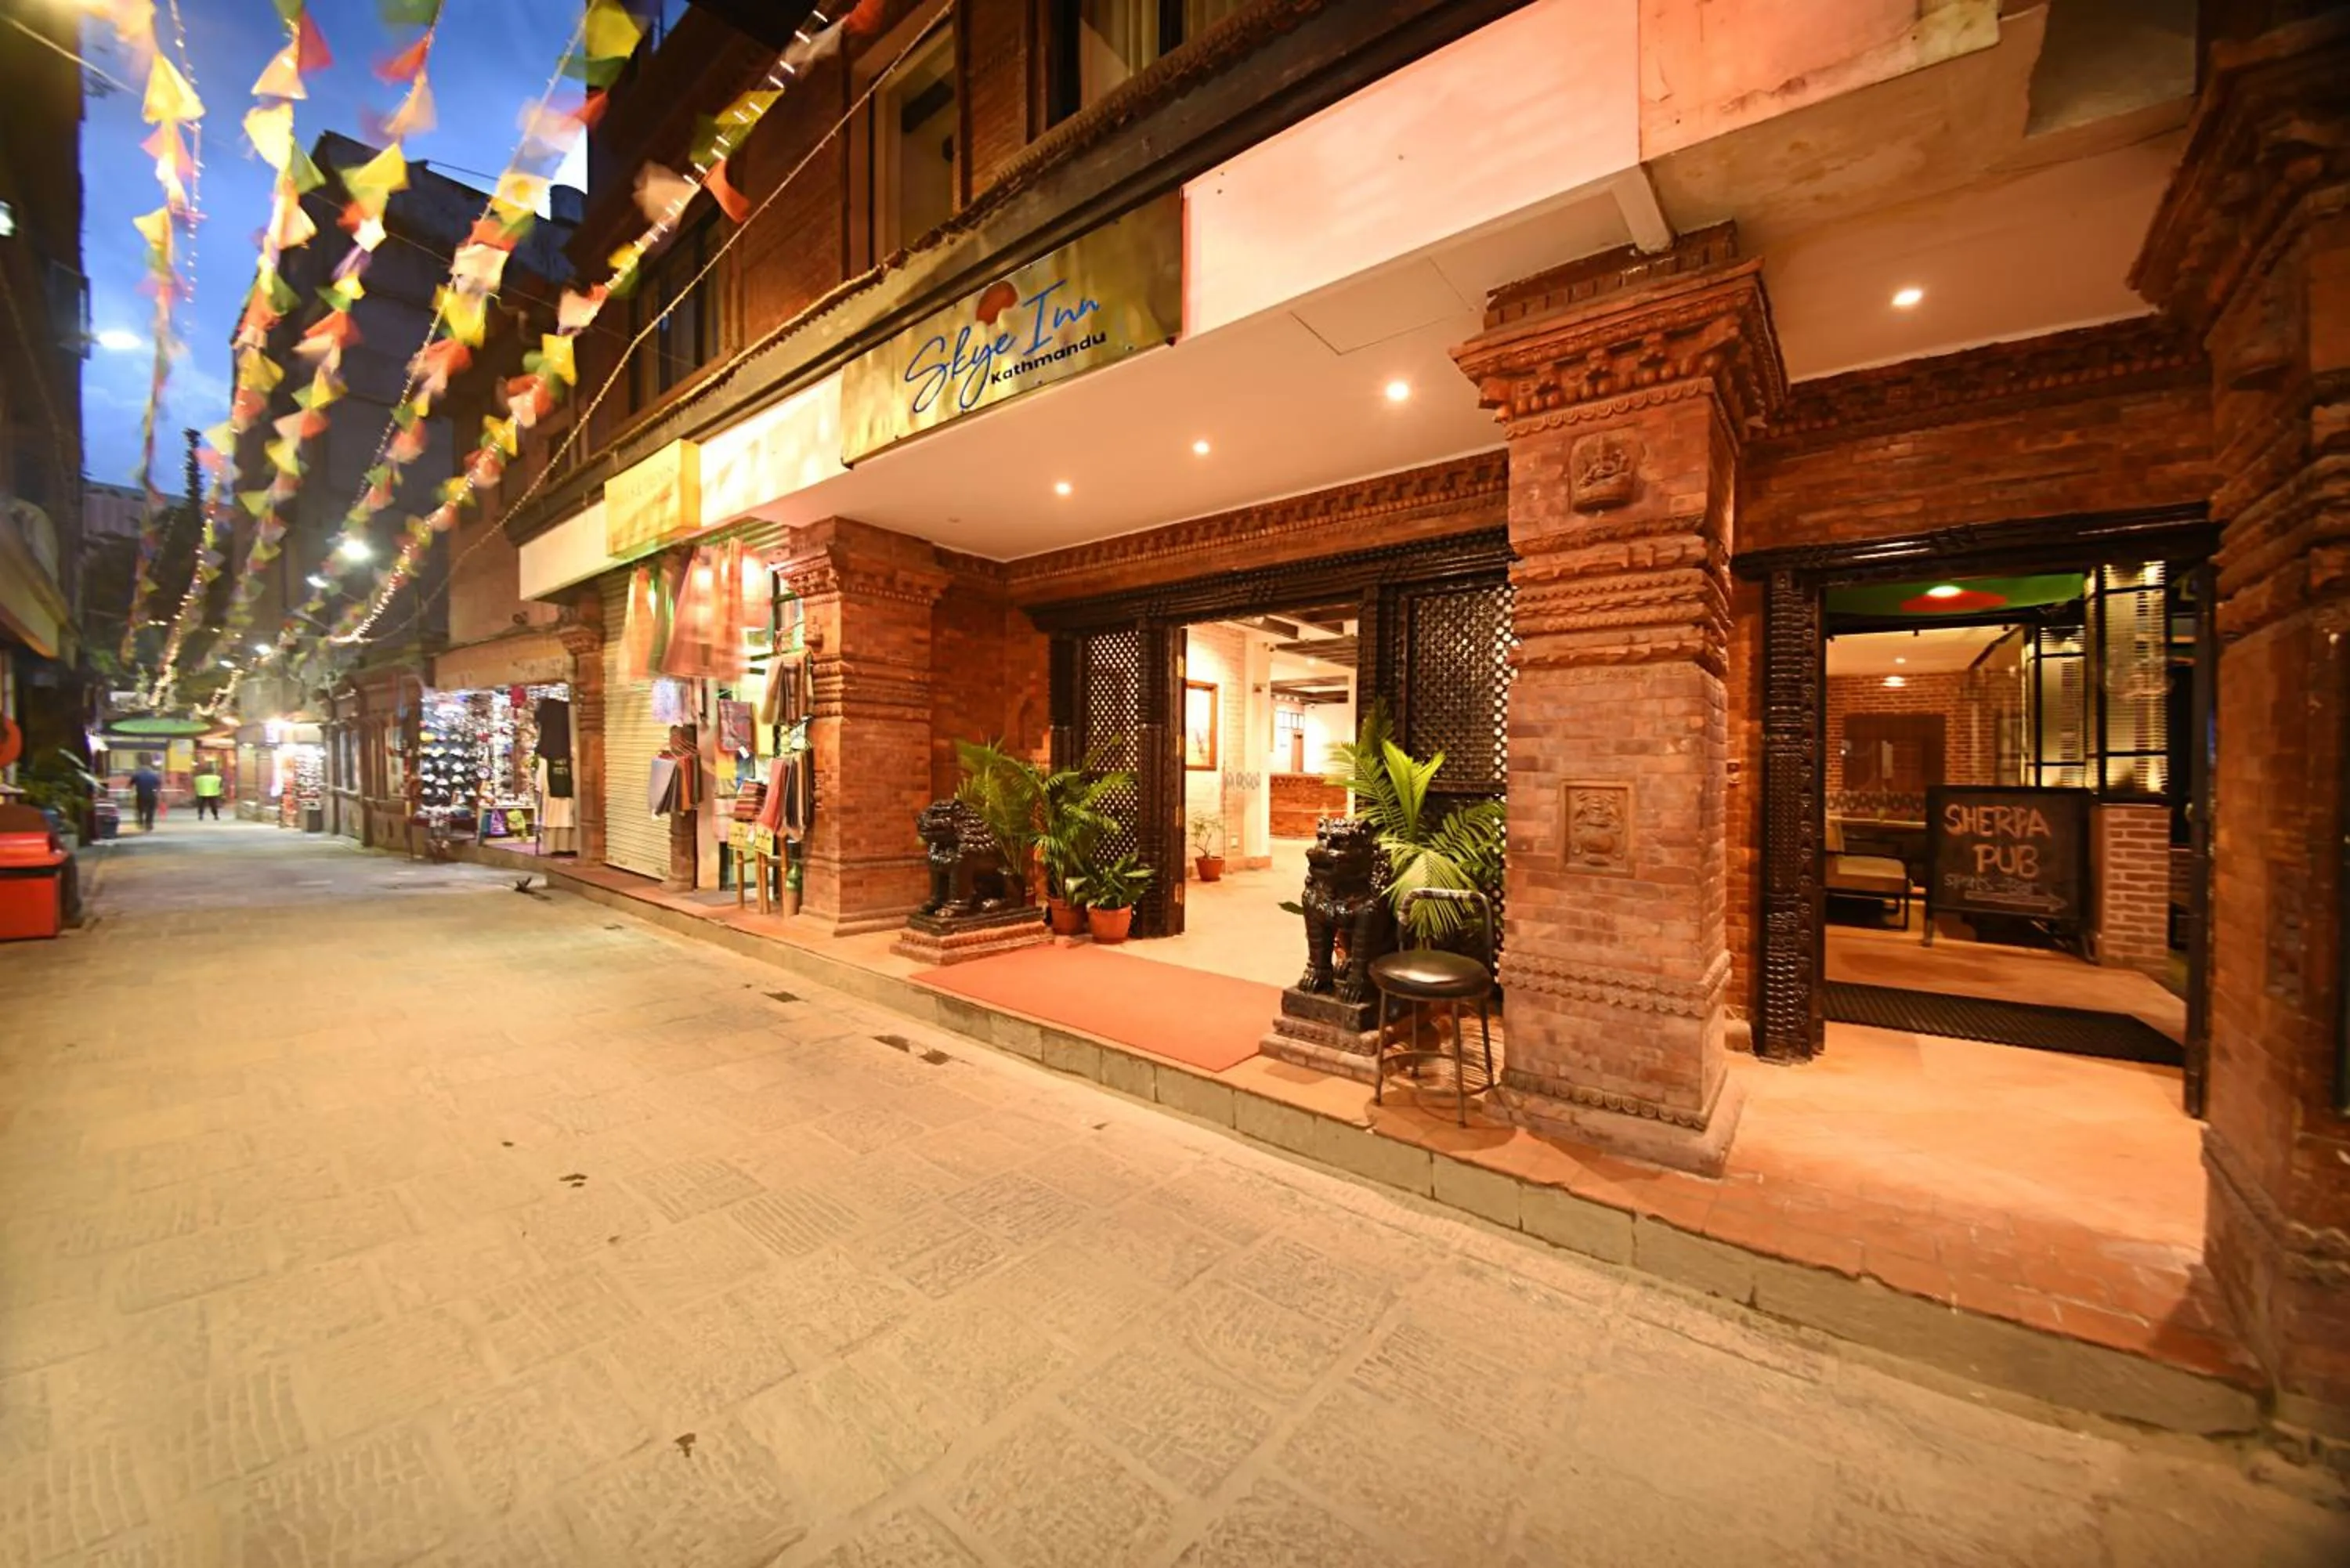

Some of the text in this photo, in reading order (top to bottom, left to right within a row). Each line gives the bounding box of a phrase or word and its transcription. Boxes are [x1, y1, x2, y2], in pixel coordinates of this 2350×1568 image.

[905, 279, 1100, 413] Skye Inn
[991, 331, 1107, 385] Kathmandu
[1944, 804, 2052, 838] SHERPA
[1973, 844, 2040, 879] PUB
